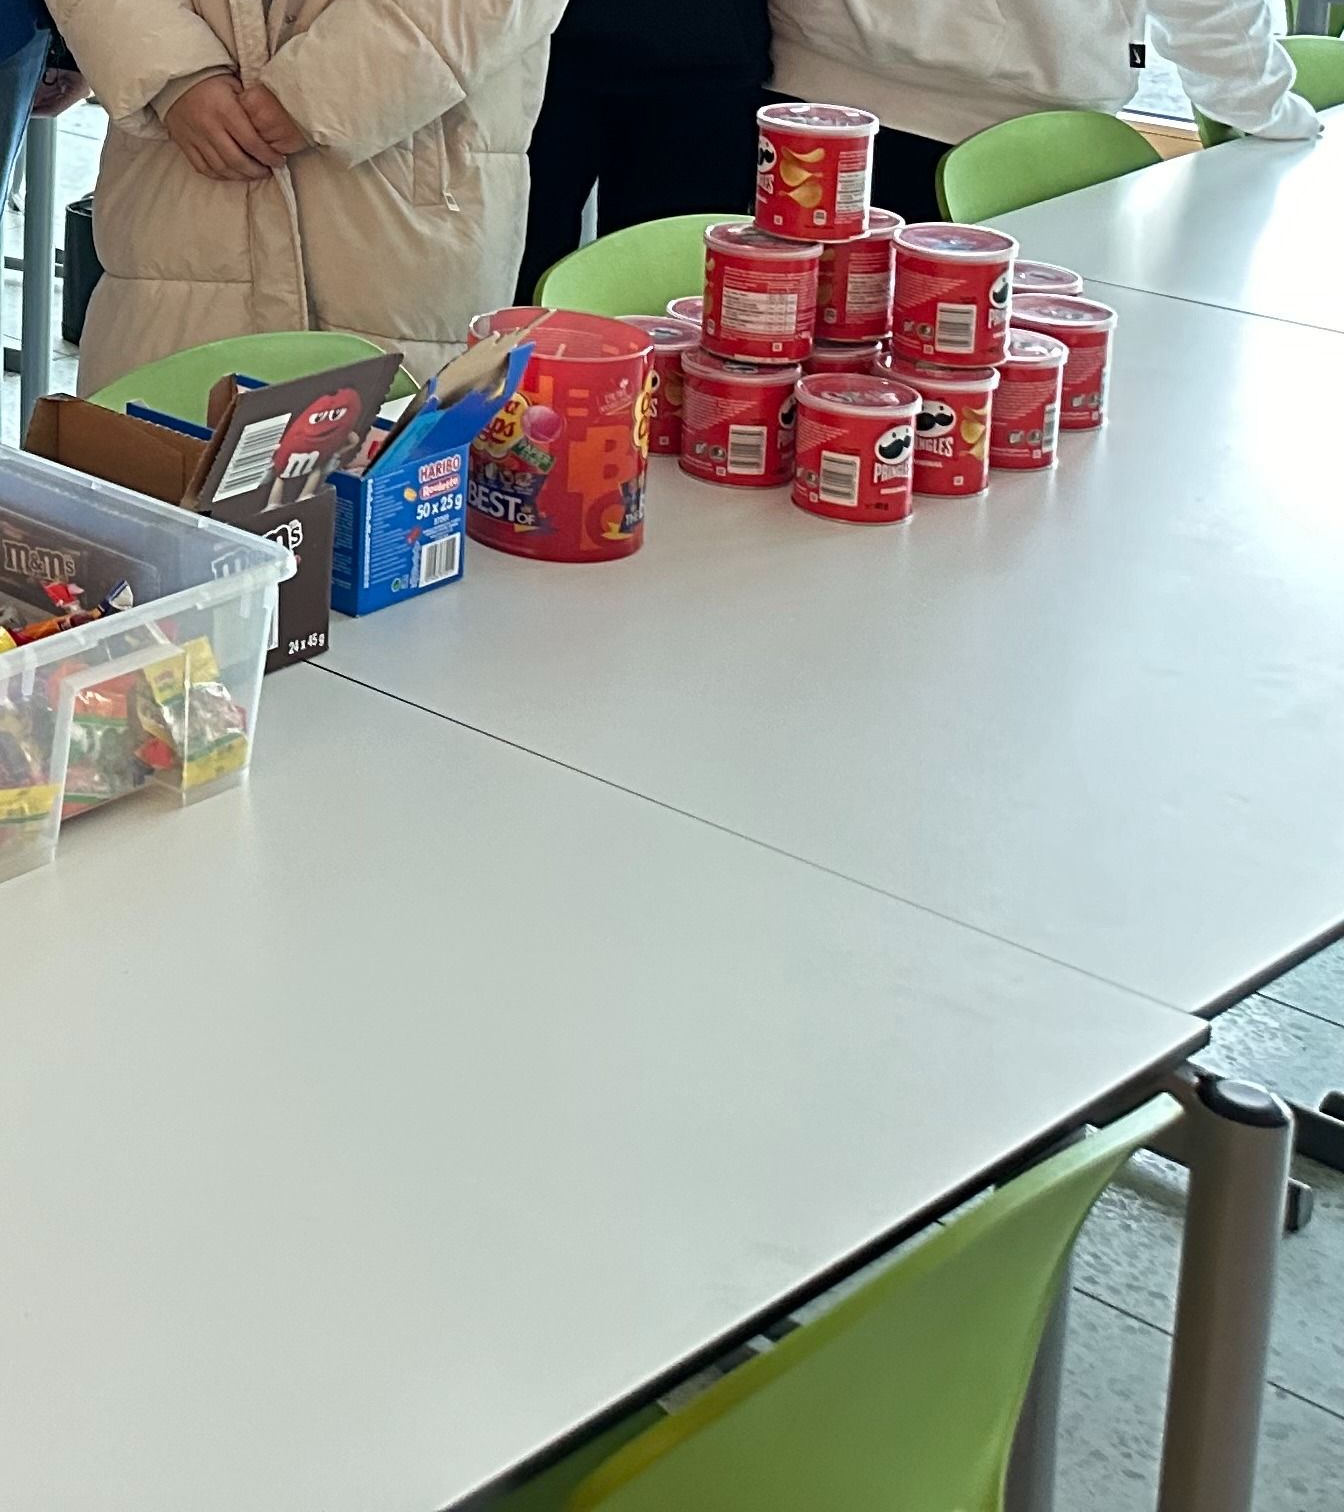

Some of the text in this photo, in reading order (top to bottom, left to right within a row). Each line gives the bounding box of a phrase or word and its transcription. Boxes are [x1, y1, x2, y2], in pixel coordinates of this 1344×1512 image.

[418, 454, 461, 484] HARIBO
[416, 502, 430, 520] 50
[431, 502, 439, 515] x
[440, 493, 453, 512] 25
[469, 480, 523, 524] BEST
